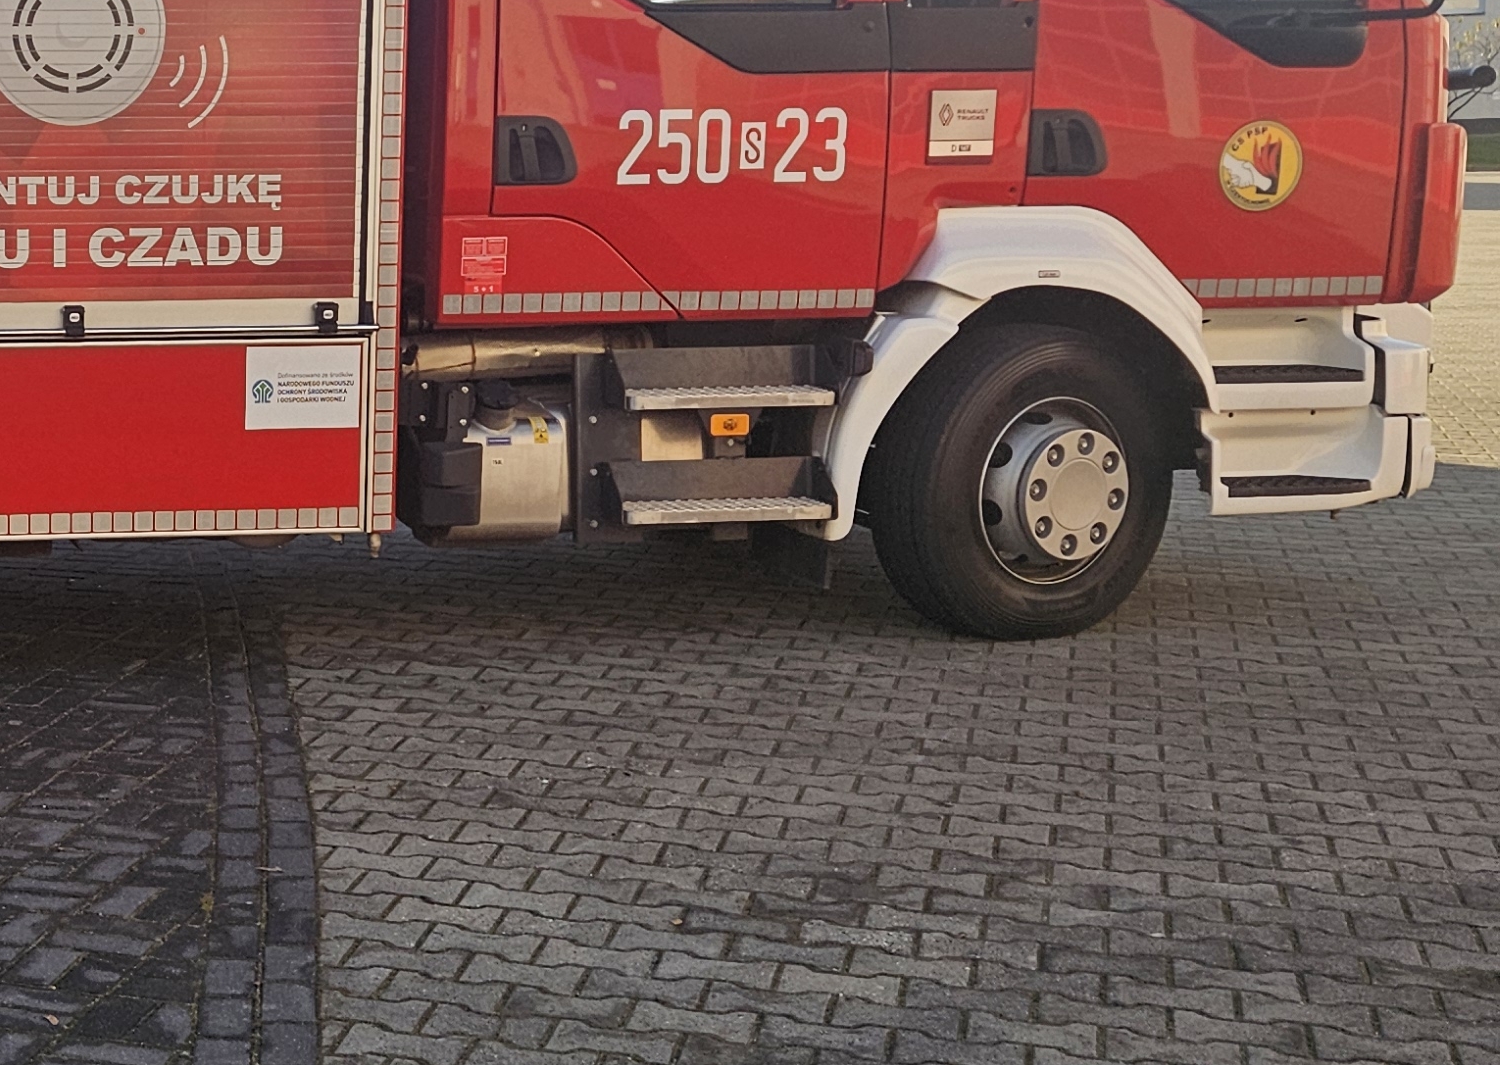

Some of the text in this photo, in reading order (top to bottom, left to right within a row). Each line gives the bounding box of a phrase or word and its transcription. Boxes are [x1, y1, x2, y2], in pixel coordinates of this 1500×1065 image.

[616, 106, 849, 185] 250 S 23
[1246, 126, 1268, 139] PSP
[114, 174, 284, 211] CZUJKĘ
[52, 228, 67, 269] I
[88, 226, 284, 269] CZADU
